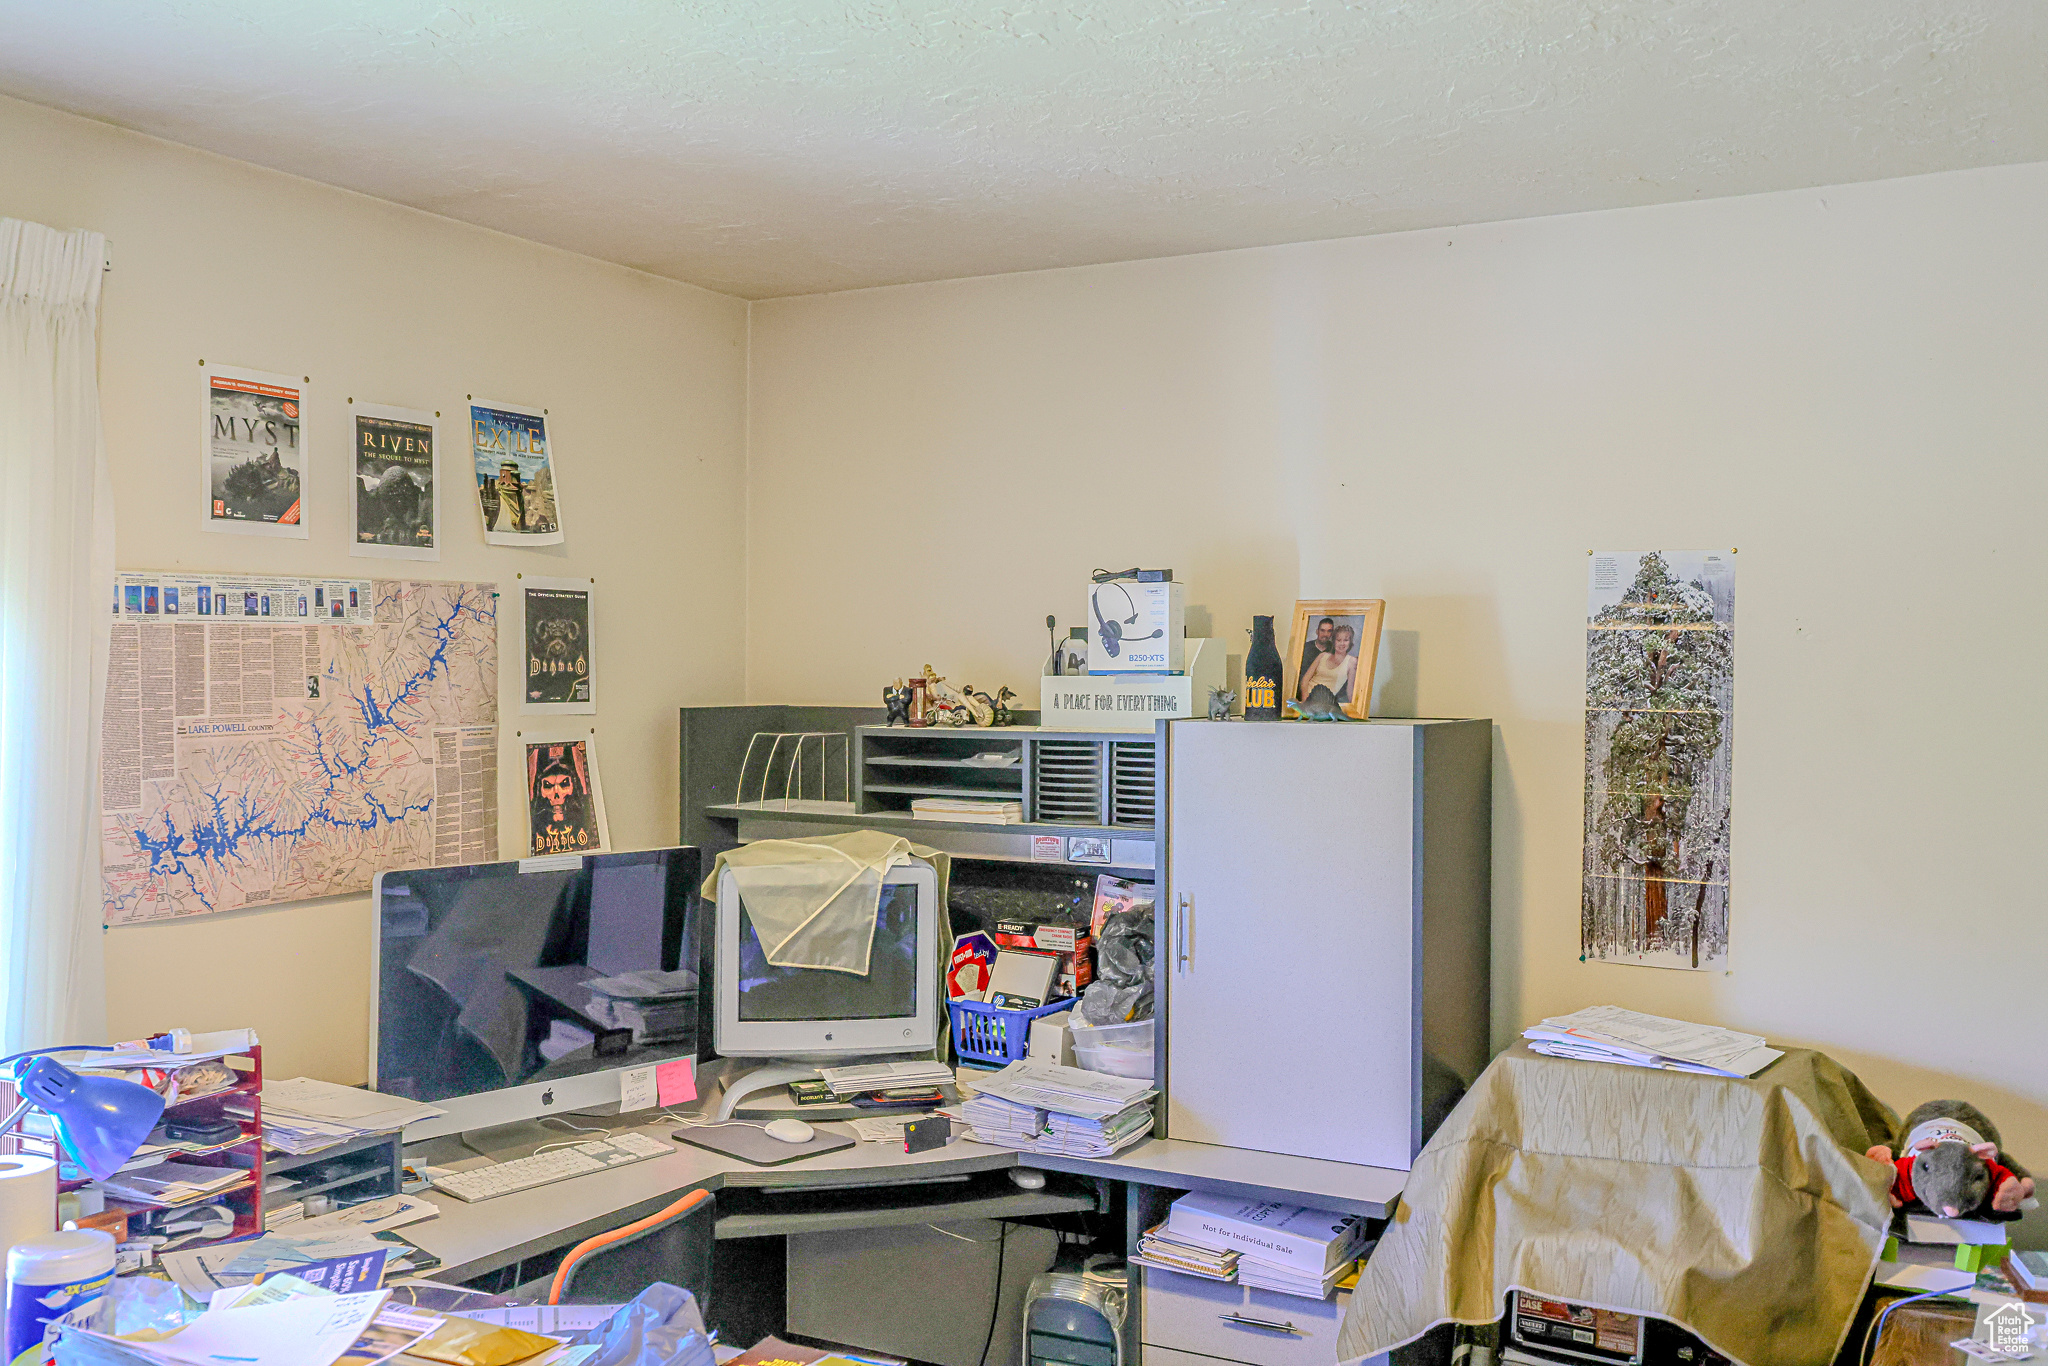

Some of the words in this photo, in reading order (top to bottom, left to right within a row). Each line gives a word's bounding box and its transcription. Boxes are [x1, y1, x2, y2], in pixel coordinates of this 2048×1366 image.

[260, 385, 284, 394] STRATEGY
[213, 414, 299, 449] MYST
[489, 419, 516, 430] MYST
[363, 431, 429, 453] RIVEN
[474, 420, 544, 455] EXILE
[378, 453, 402, 461] SEQUEL
[413, 457, 429, 465] MYST
[530, 654, 587, 676] DIABLO
[1128, 654, 1164, 662] B250-XTS
[1053, 693, 1060, 709] A
[1063, 693, 1091, 711] PLACE
[1094, 694, 1113, 711] FOR
[1116, 694, 1178, 712] EVERYTHING
[1246, 688, 1275, 709] LUB
[188, 724, 210, 735] LAKE
[212, 723, 247, 733] POWELL
[1202, 1223, 1217, 1233] Not
[1218, 1227, 1231, 1237] for
[1232, 1232, 1274, 1250] Individual
[1275, 1244, 1293, 1255] Sale
[1519, 1298, 1543, 1312] CASE
